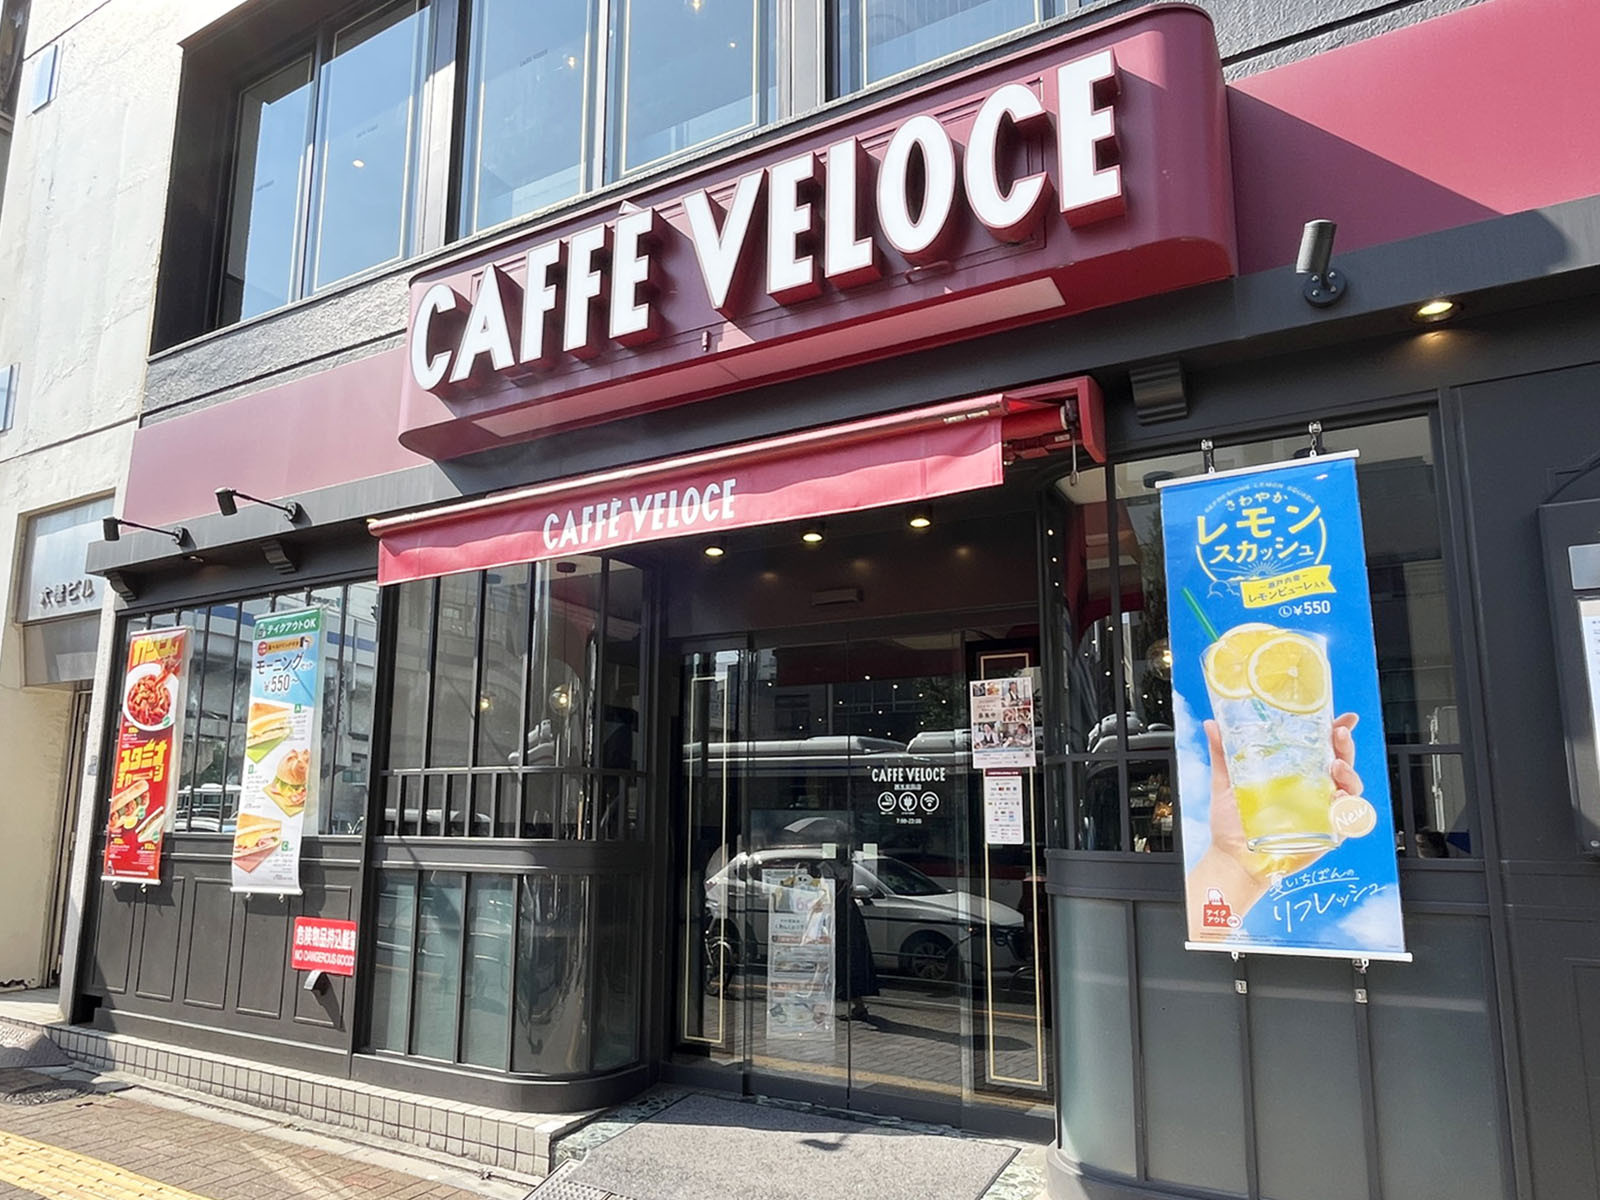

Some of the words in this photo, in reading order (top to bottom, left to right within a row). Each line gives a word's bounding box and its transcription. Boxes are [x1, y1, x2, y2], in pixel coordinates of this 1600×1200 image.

[411, 202, 655, 392] CAFFÈ
[681, 48, 1124, 311] VELOCE
[542, 497, 622, 550] CAFFÈ
[629, 478, 737, 533] VELOCE
[1226, 491, 1289, 511] さわやか
[1197, 504, 1321, 545] レモン
[1209, 536, 1315, 564] スカッシュ
[1293, 600, 1331, 615] ¥550
[120, 737, 168, 772] スタミナ
[905, 766, 946, 783] VELOCE
[1335, 804, 1369, 831] New
[1273, 882, 1387, 933] リフレッシュ
[294, 949, 304, 961] NO
